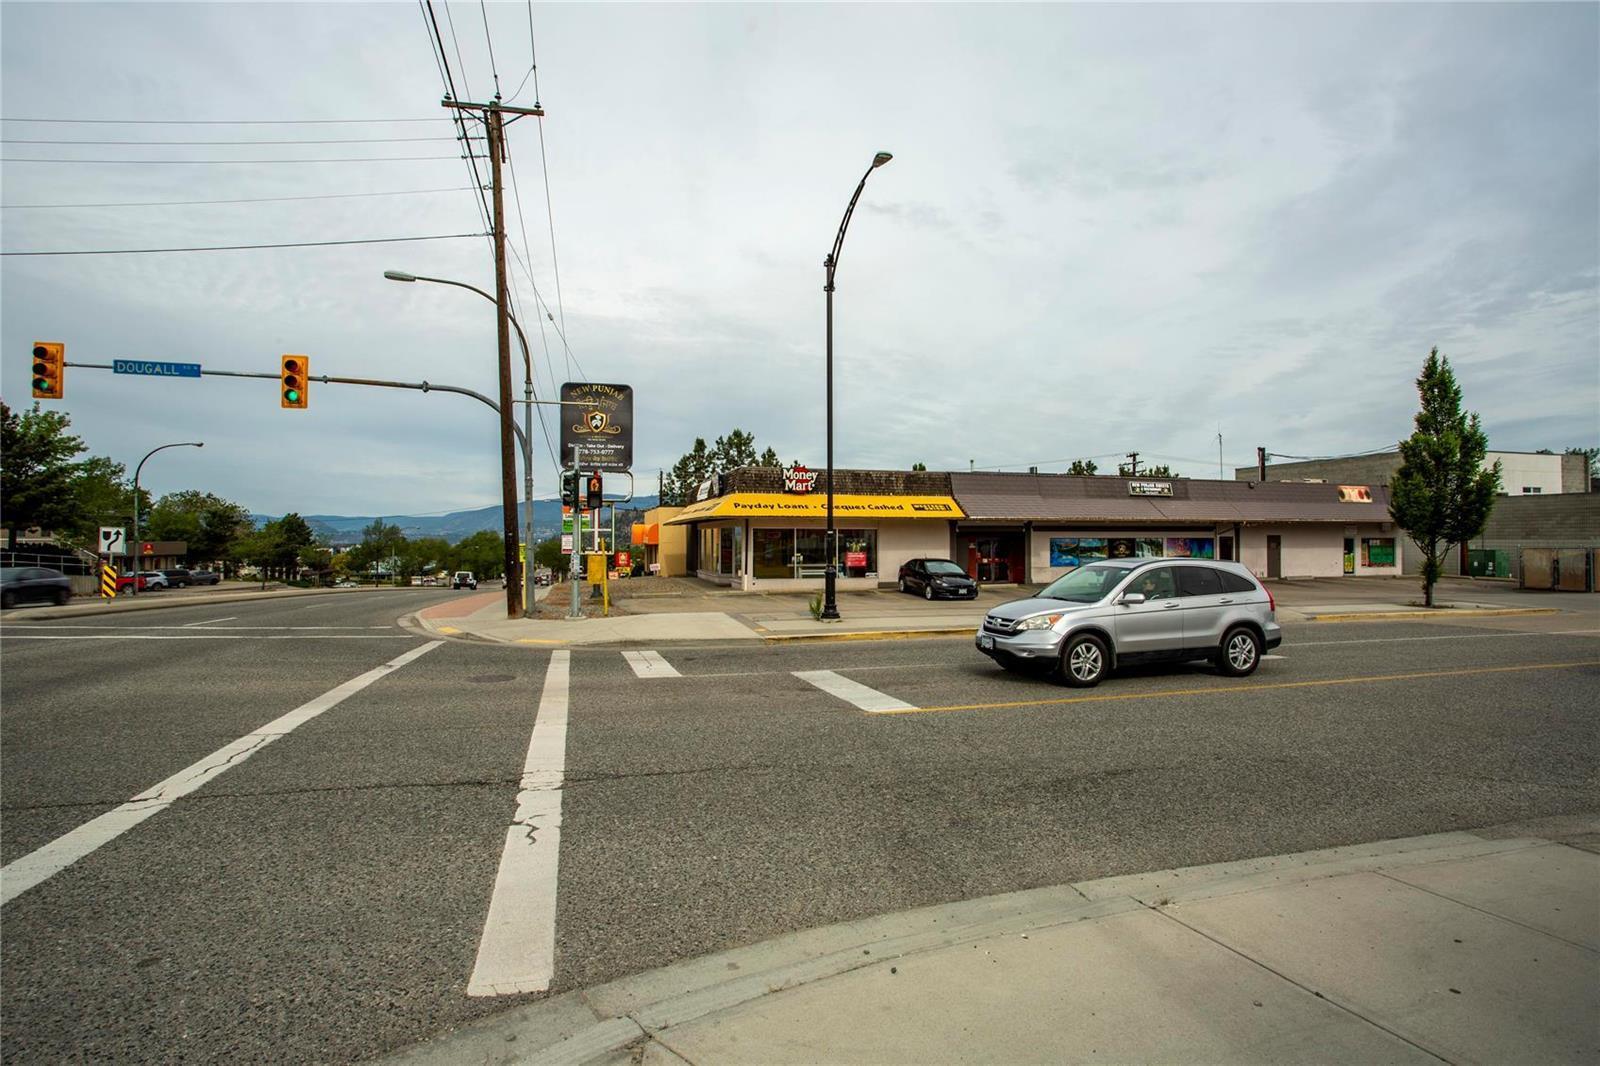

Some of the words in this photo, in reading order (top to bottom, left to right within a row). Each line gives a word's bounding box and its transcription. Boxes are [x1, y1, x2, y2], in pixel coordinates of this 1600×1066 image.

[117, 361, 180, 375] DOUGALL
[570, 384, 591, 396] NEW
[592, 384, 625, 401] PUNJAB
[782, 468, 819, 483] Money
[784, 480, 814, 491] Mart
[733, 502, 775, 510] Payday
[777, 502, 809, 510] Loans
[821, 503, 866, 511] Ceques
[867, 503, 904, 511] Cashed
